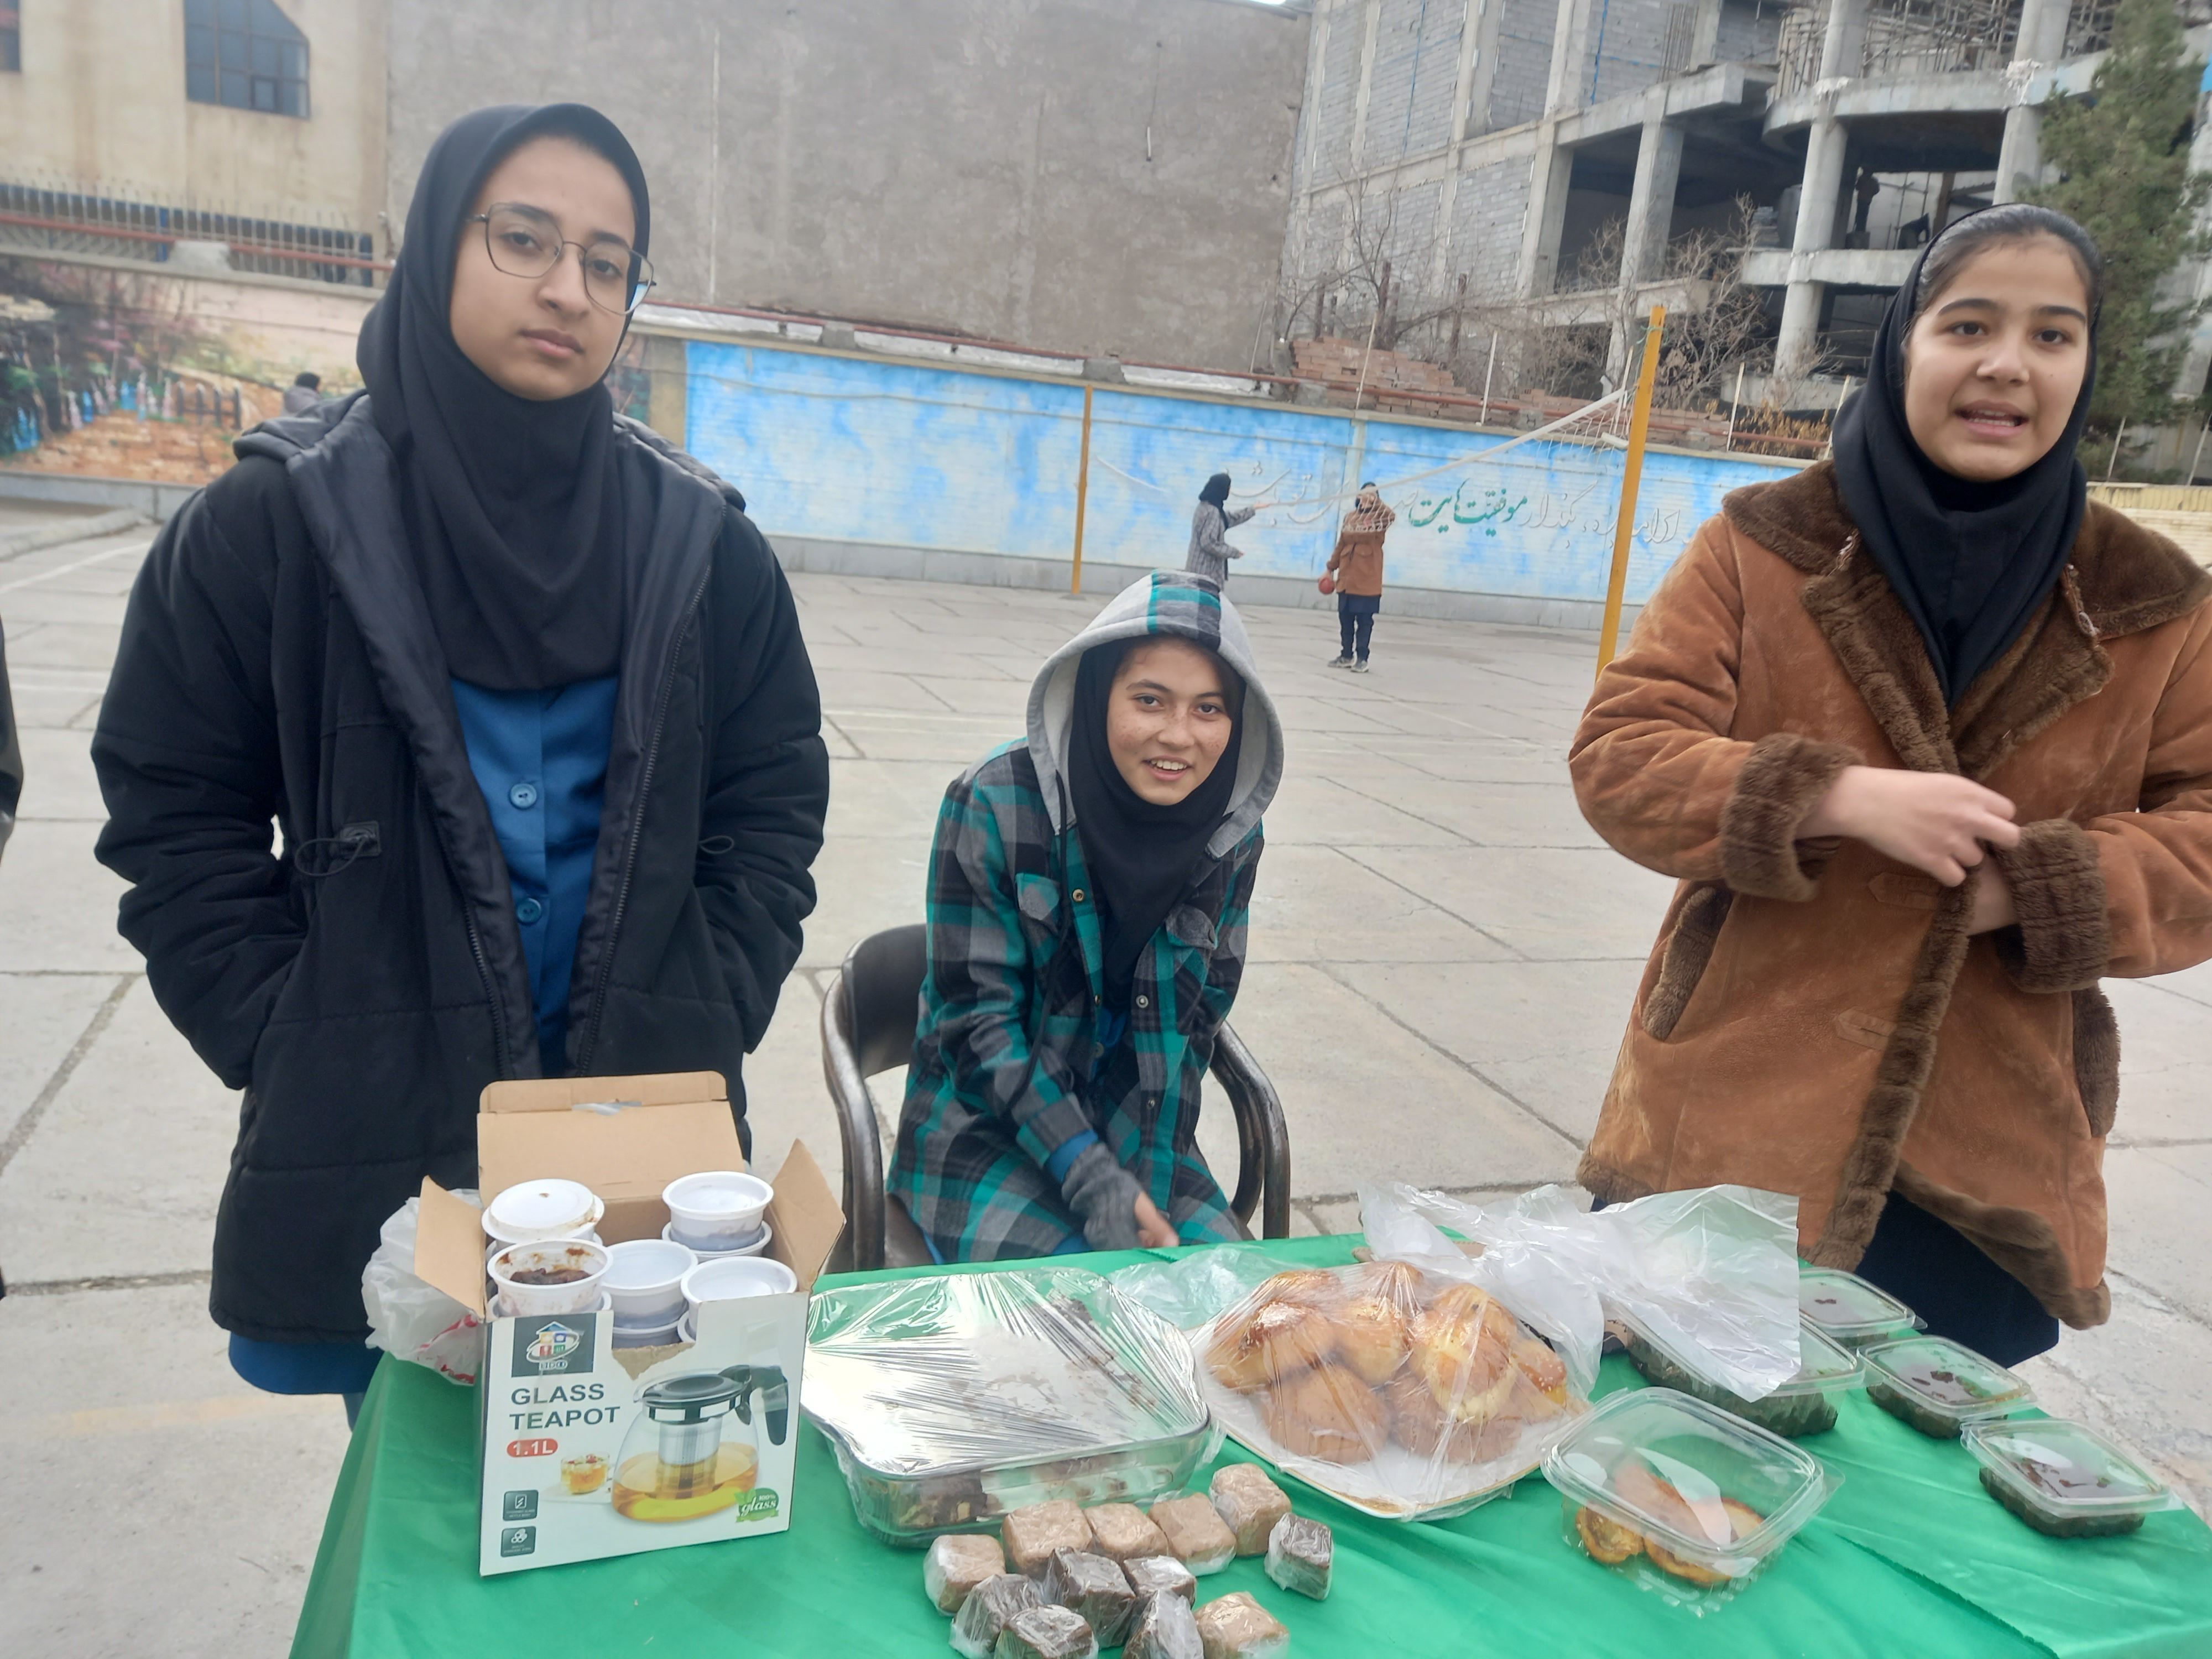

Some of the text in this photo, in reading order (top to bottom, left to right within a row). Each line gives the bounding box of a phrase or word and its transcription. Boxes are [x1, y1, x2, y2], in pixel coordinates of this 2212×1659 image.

[511, 1383, 604, 1405] GLASS
[509, 1406, 620, 1430] TEAPOT
[513, 1440, 553, 1455] 1.1L
[740, 1496, 777, 1516] glass
